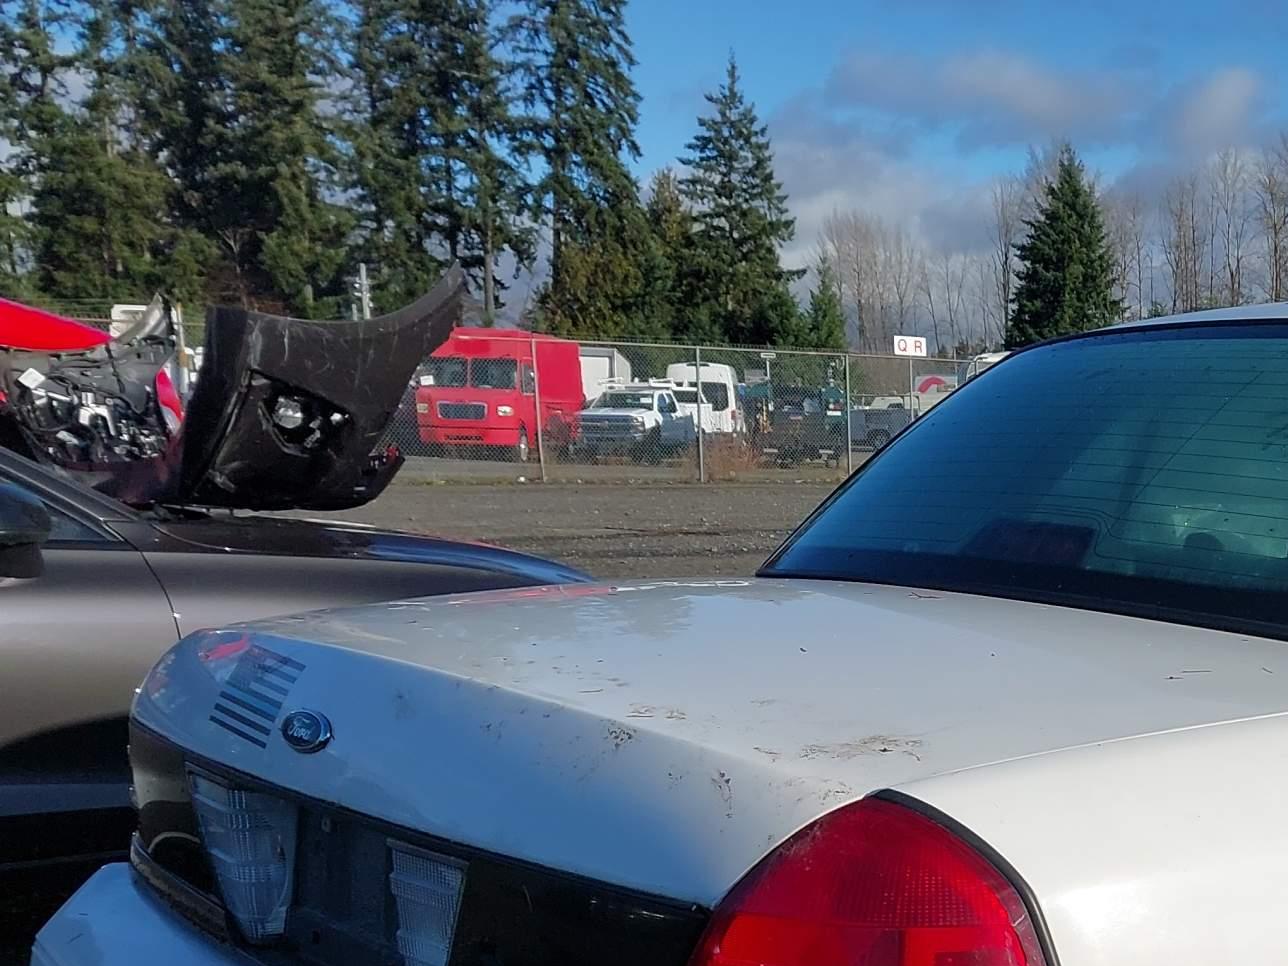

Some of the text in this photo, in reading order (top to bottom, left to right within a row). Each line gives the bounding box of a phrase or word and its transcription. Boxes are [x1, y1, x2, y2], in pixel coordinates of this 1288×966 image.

[897, 339, 923, 353] Q R
[287, 715, 315, 740] Ford
